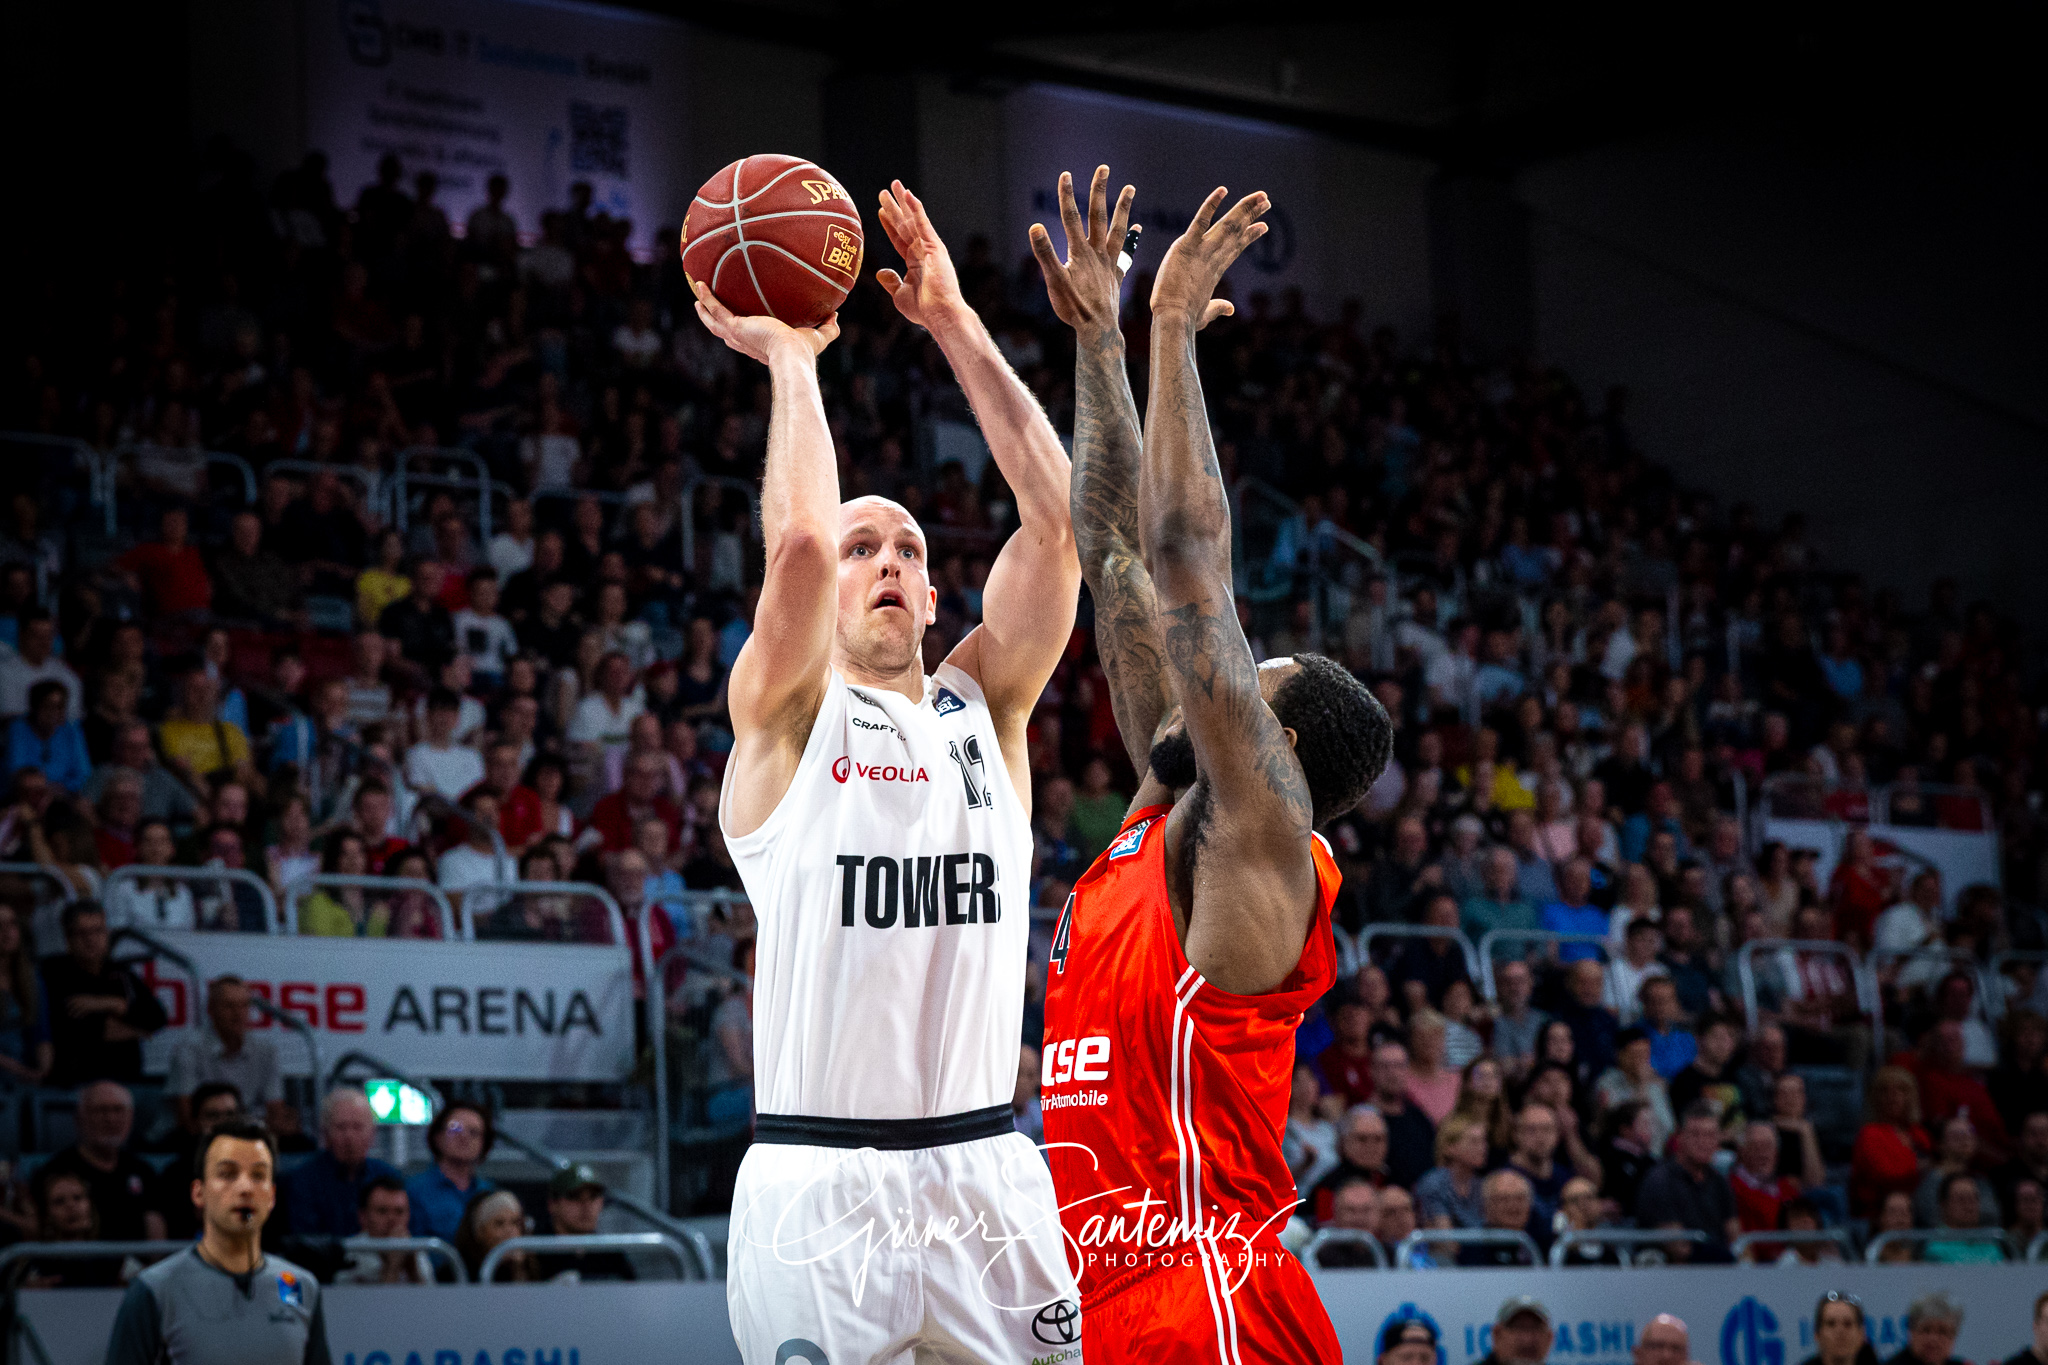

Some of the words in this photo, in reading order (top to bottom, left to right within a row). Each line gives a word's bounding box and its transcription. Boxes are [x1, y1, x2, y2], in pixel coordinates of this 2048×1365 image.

[827, 246, 854, 272] BBL
[852, 717, 896, 733] CRAFT
[855, 762, 929, 782] VEOLIA
[836, 853, 1001, 929] TOWER
[384, 985, 601, 1035] ARENA
[1031, 1348, 1081, 1365] Autoha
